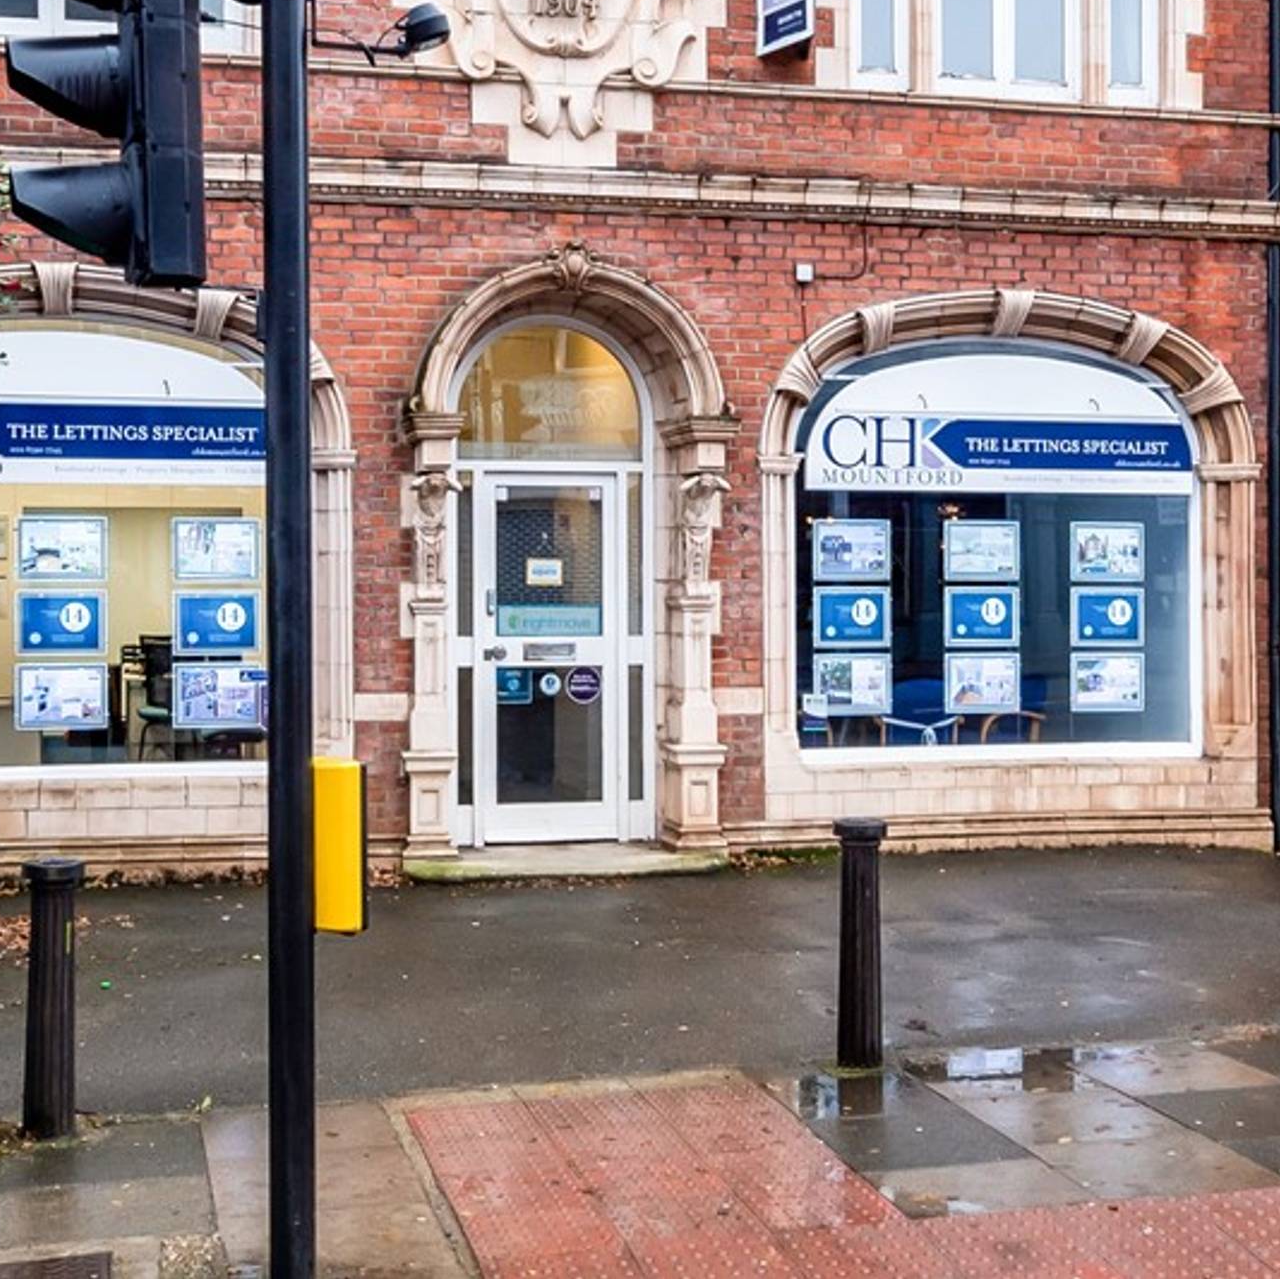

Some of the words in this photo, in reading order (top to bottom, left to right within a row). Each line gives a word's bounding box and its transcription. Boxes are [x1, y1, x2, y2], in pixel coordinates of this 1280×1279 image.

[6, 422, 48, 439] THE
[53, 423, 149, 441] LETTINGS
[152, 425, 260, 443] SPECIALIST
[965, 436, 1000, 453] THE
[1002, 437, 1081, 454] LETTINGS
[1082, 439, 1169, 456] SPECIALIST
[822, 468, 963, 486] MOUNTFORD
